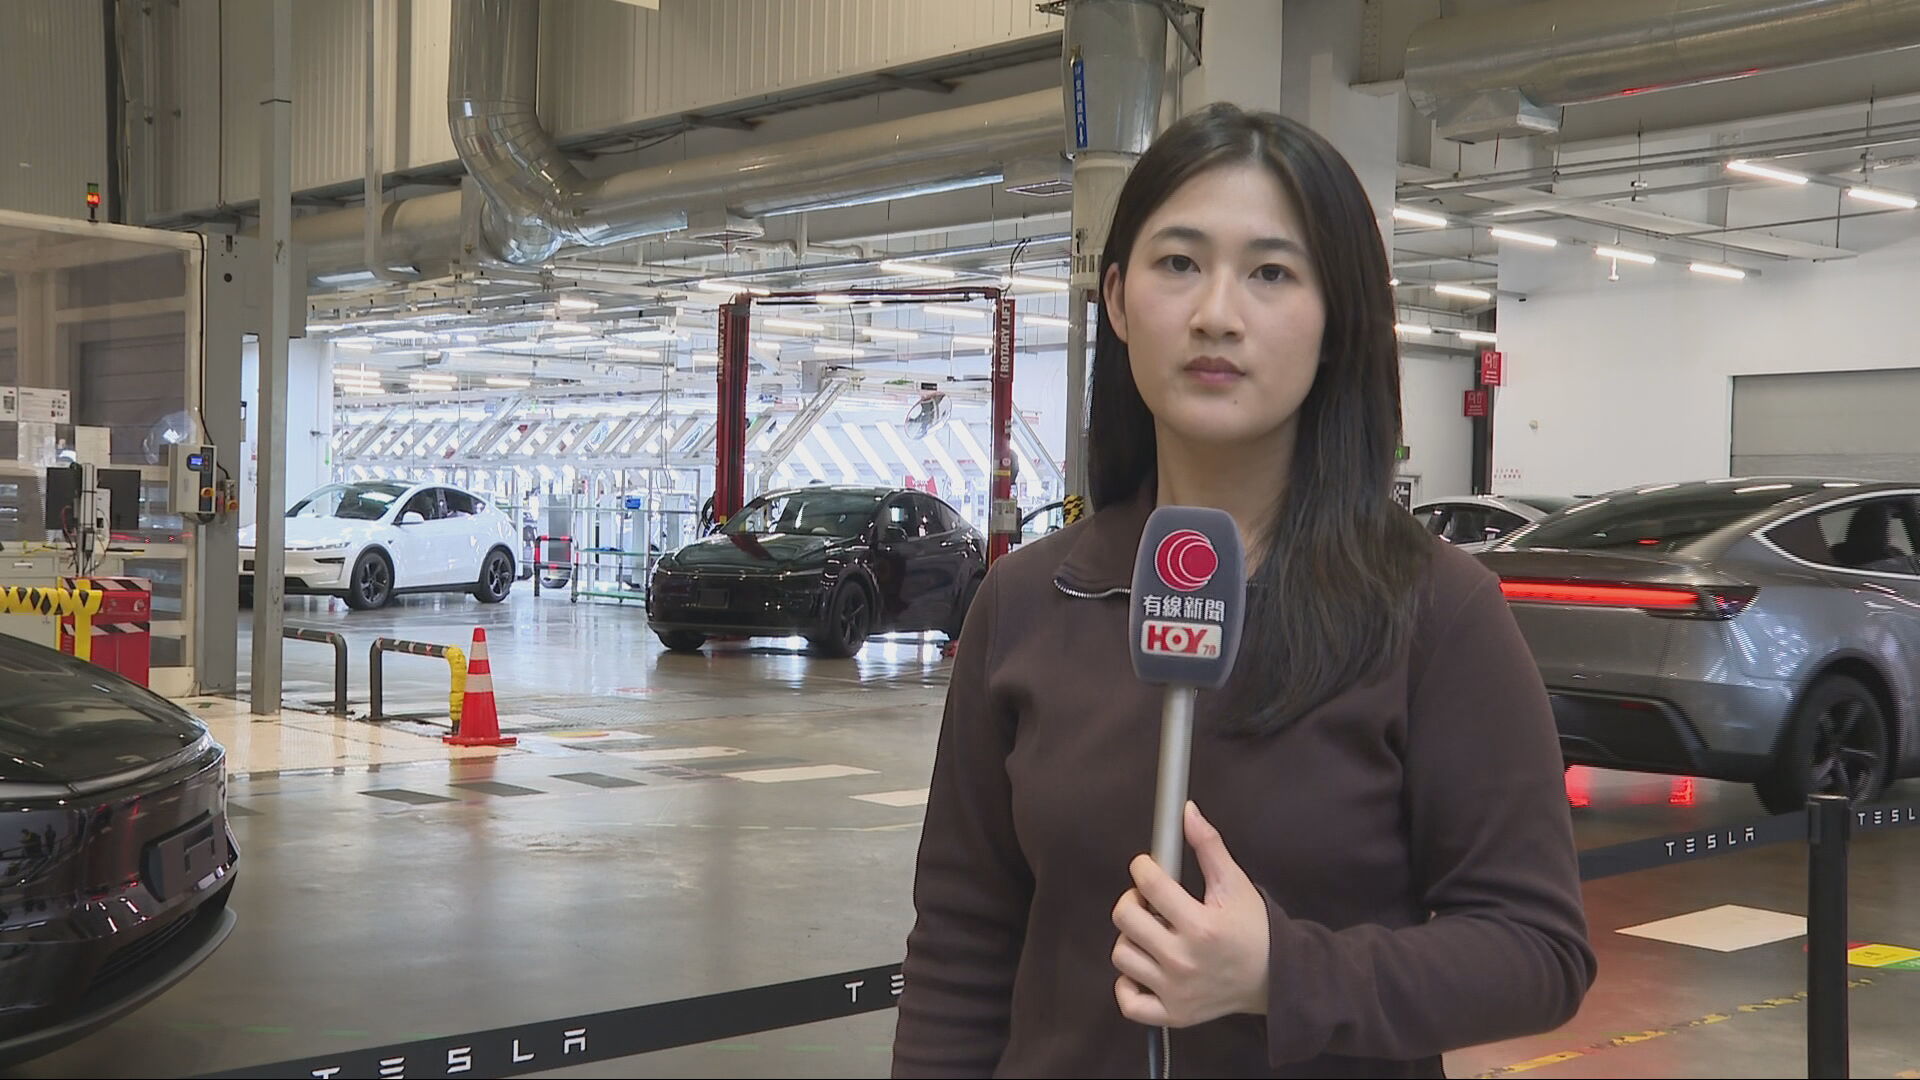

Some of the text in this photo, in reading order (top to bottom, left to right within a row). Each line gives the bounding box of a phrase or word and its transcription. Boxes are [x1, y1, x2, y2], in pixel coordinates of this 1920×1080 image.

[1000, 301, 1011, 372] ROTARY LIFT
[1143, 594, 1225, 622] 有線新聞
[1146, 625, 1208, 654] HOY
[1666, 827, 1755, 857] TESLA
